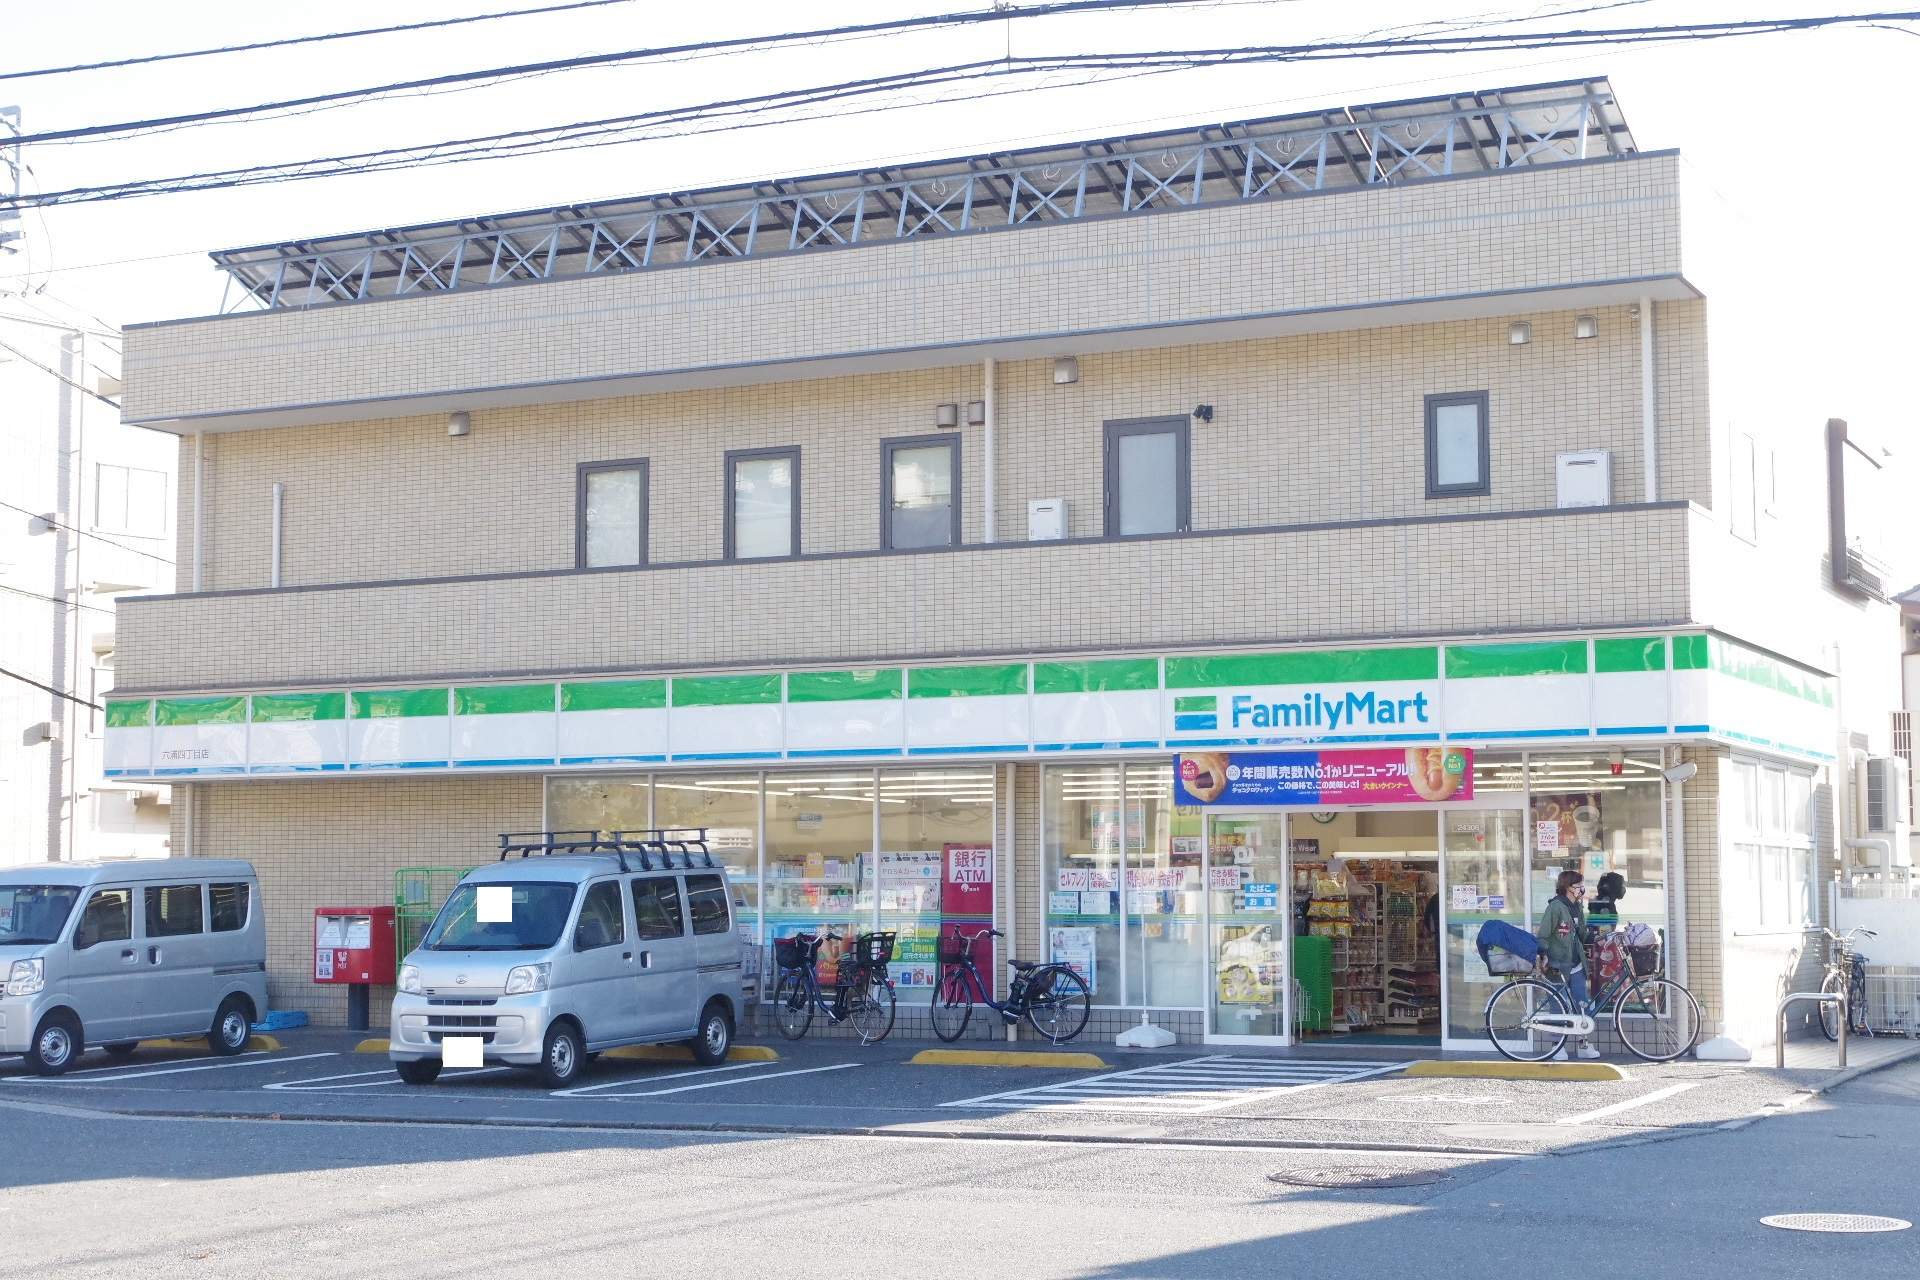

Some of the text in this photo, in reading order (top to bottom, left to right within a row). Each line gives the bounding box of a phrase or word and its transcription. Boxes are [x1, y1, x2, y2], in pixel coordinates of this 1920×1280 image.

[1232, 691, 1429, 730] FamilyMart
[955, 851, 986, 867] 銀行
[955, 870, 986, 881] ATM
[1249, 884, 1271, 893] たばこ
